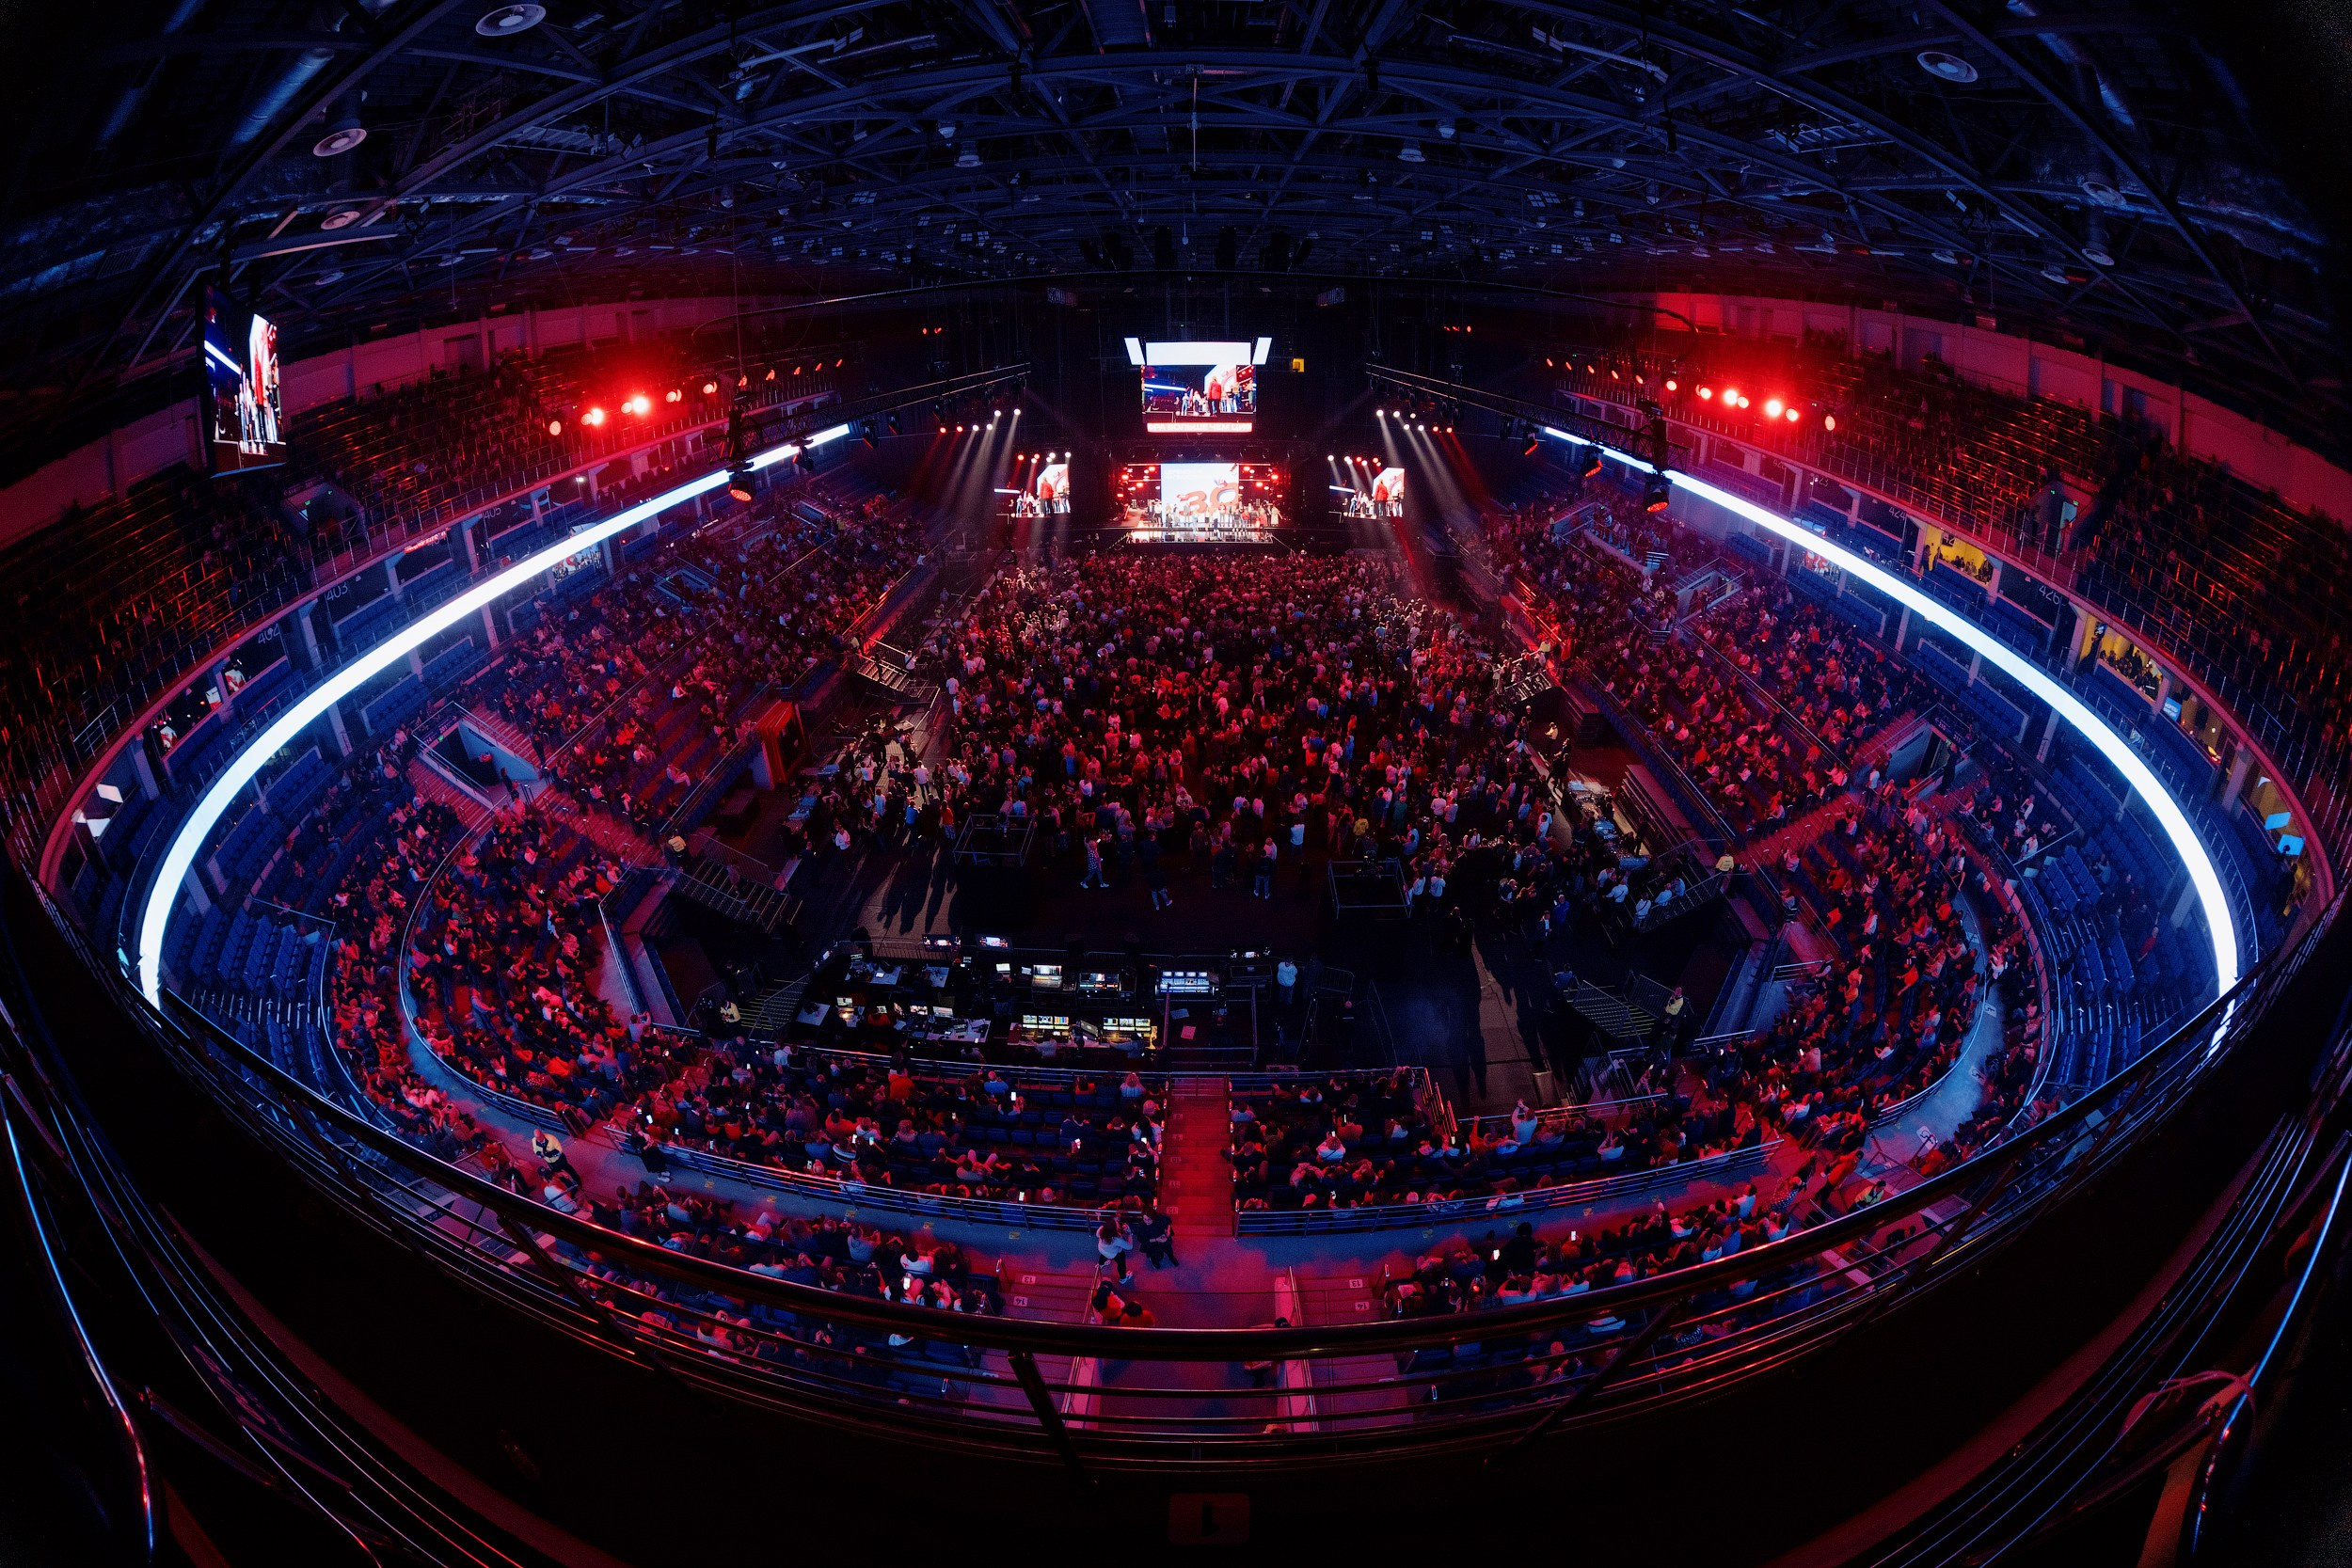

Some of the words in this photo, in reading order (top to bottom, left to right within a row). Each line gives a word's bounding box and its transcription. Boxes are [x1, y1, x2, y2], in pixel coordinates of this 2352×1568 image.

[485, 507, 501, 519] 405
[326, 581, 348, 601] 403
[2039, 585, 2060, 605] 426
